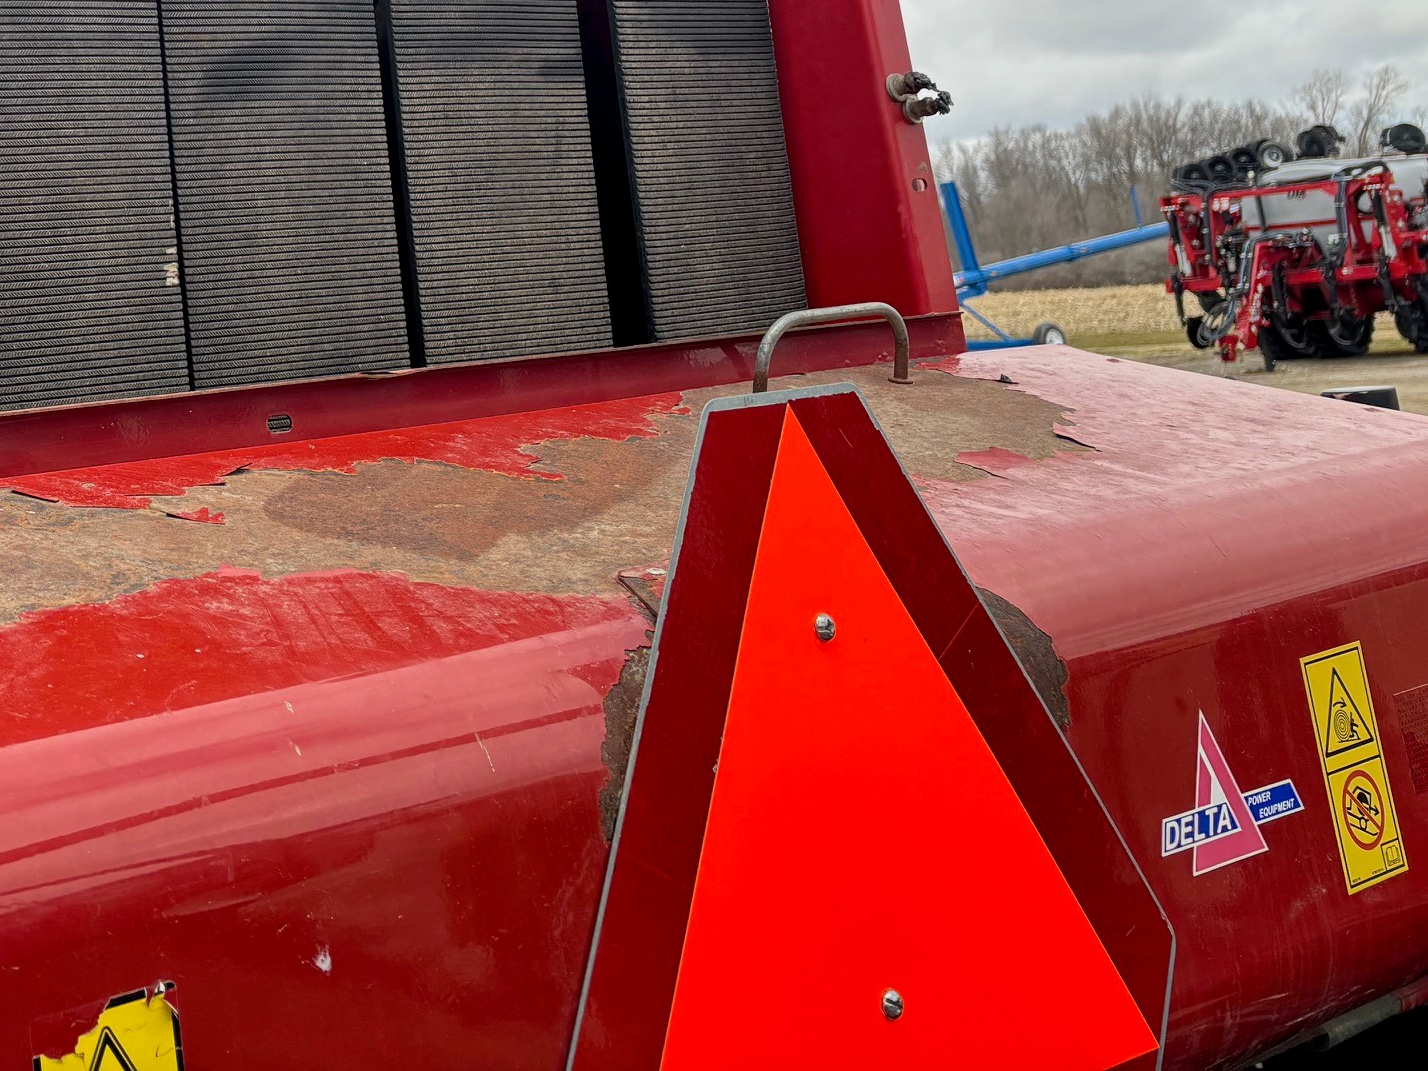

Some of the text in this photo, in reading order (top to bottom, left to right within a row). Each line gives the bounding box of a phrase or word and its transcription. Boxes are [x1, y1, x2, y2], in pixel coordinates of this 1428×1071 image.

[1248, 792, 1272, 806] POWER
[1259, 799, 1295, 819] EQUIPMENT
[1166, 804, 1232, 851] DELTA
